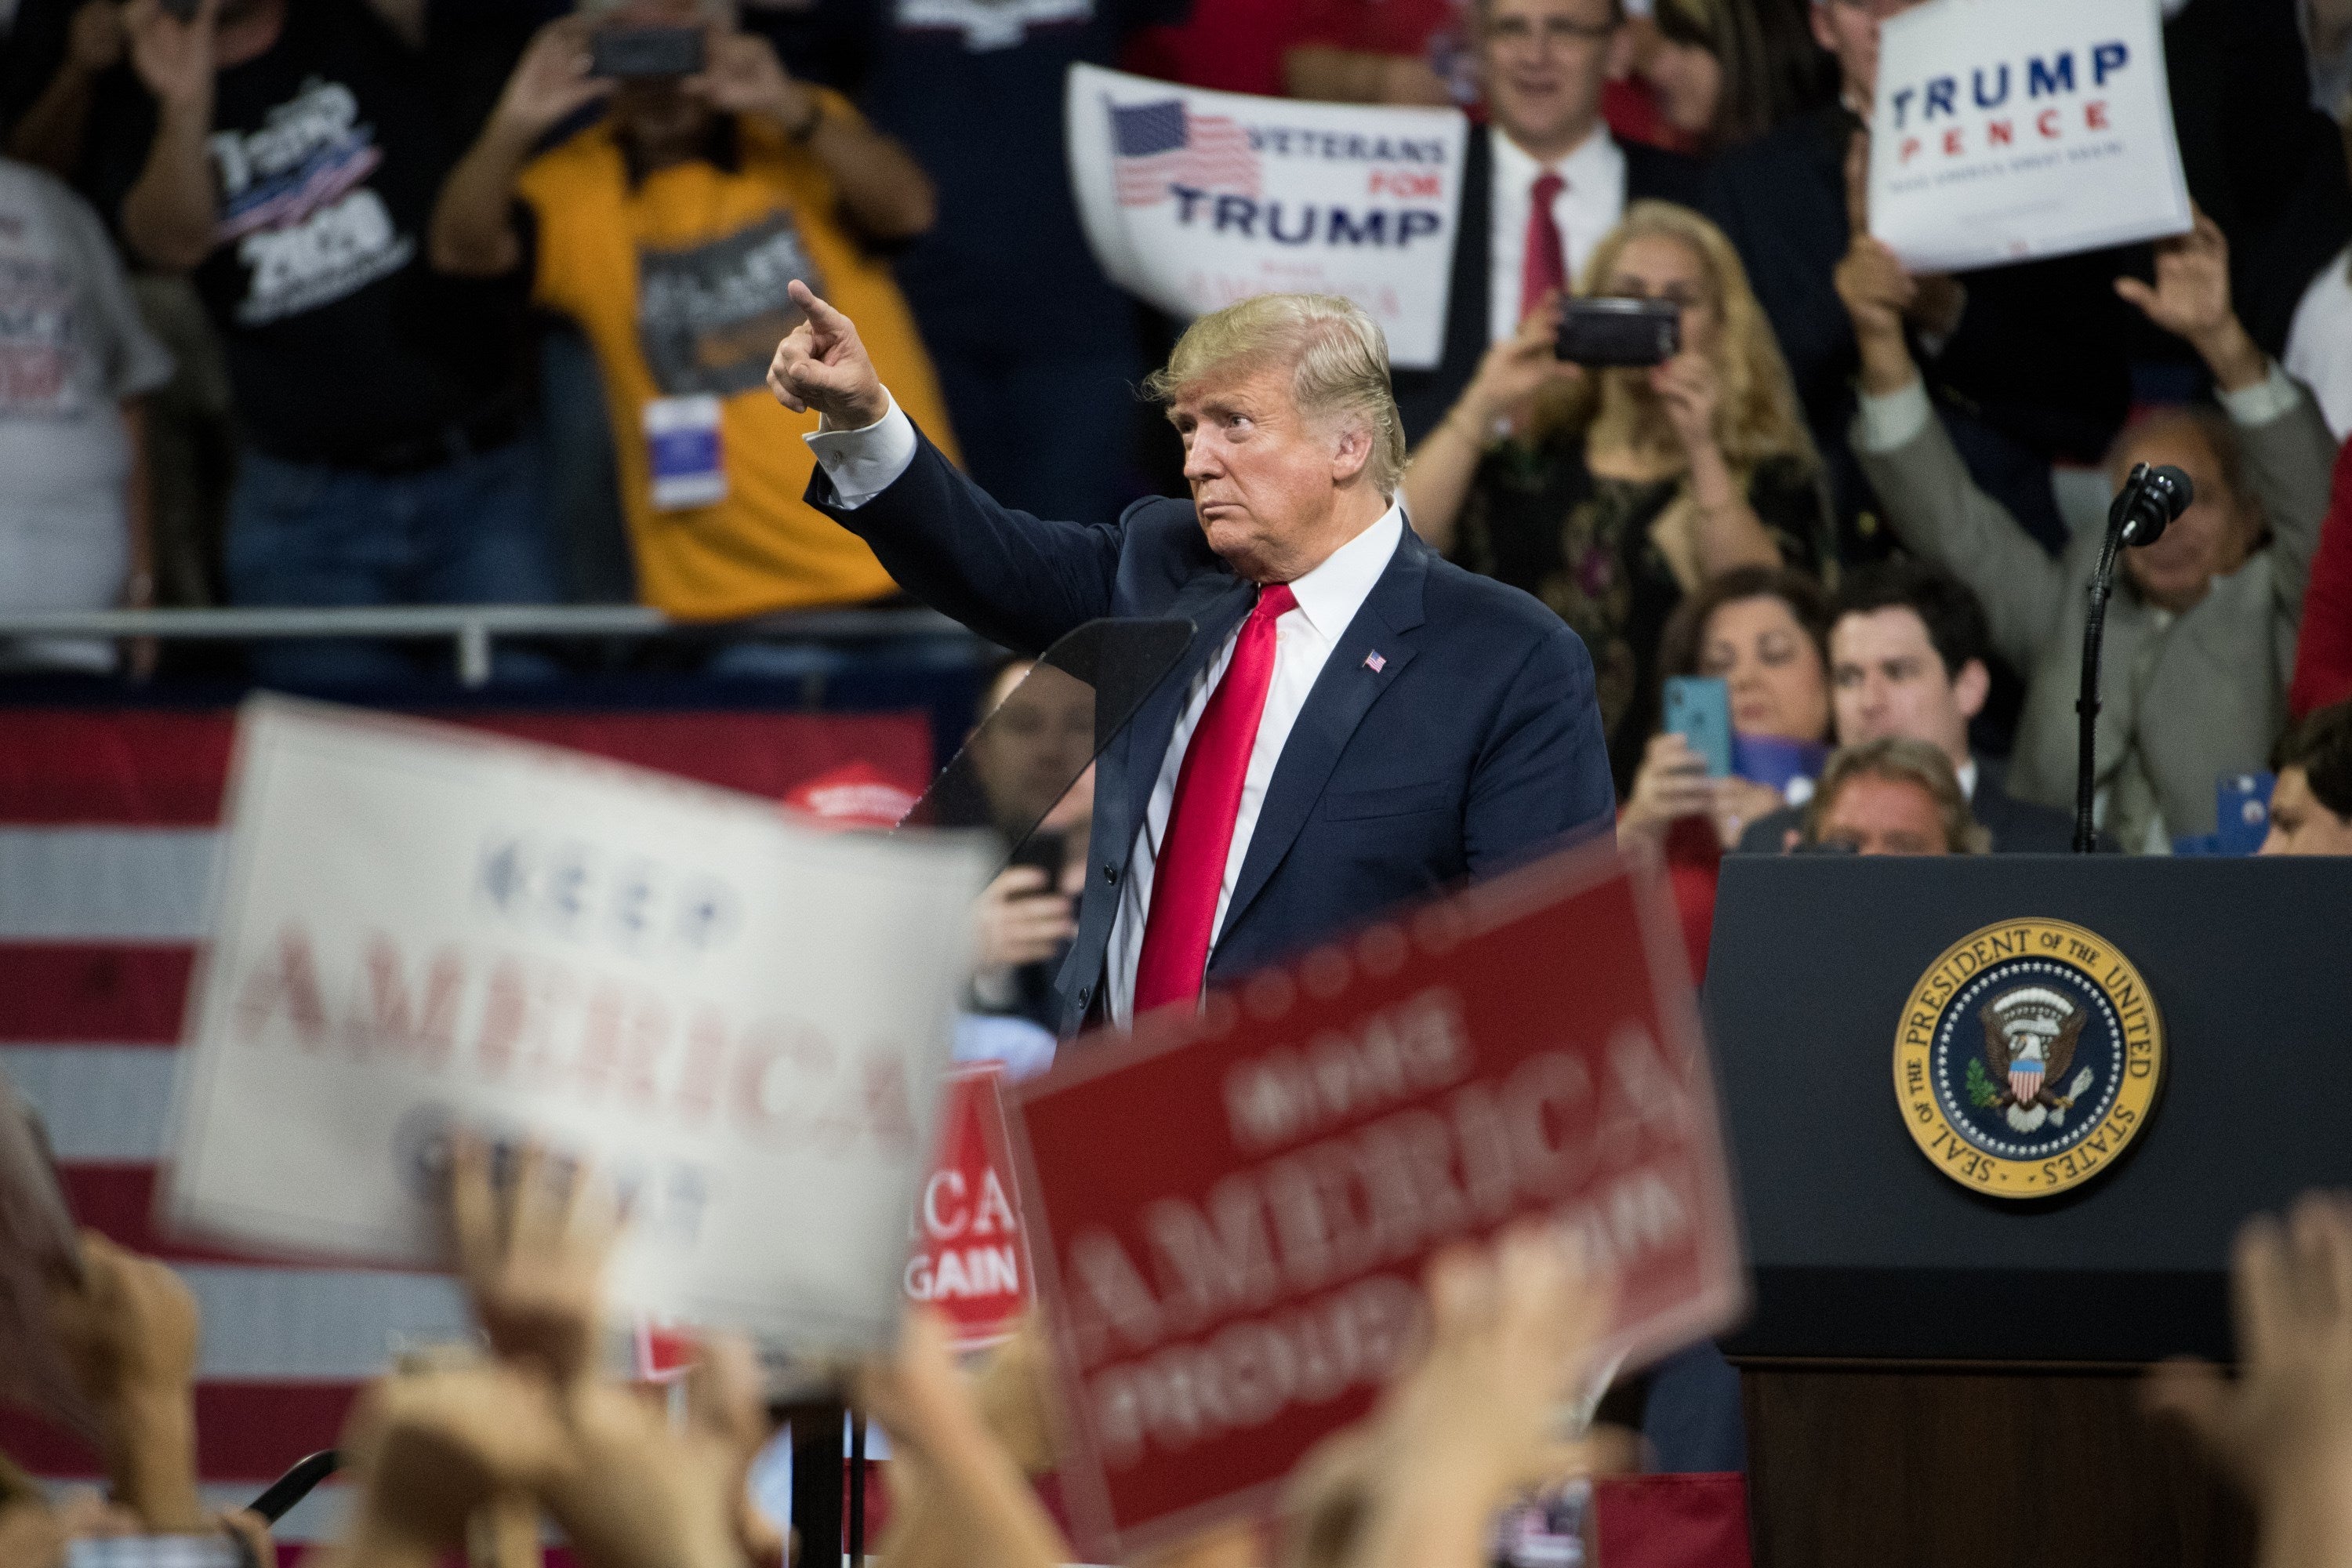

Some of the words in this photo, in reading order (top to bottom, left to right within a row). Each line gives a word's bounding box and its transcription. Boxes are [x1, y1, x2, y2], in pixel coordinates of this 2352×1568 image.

[1891, 38, 2131, 129] TRUMP
[1250, 125, 1447, 165] VETERANS
[1898, 100, 2111, 165] PENCE
[1170, 181, 1443, 250] TRUMP
[1368, 169, 1442, 198] FOR
[2069, 940, 2101, 967] THE
[1906, 929, 2031, 1046] PRESIDENT
[234, 920, 928, 1162] AMERICA
[2103, 966, 2152, 1079] UNITED
[1221, 985, 1472, 1149] MAKE
[1907, 1058, 1923, 1094] THE
[1915, 1102, 1933, 1123] OF
[2042, 1104, 2136, 1185] STATES
[1069, 1019, 1690, 1353] AMERICA
[1929, 1123, 1996, 1182] SEAL
[903, 1247, 1019, 1301] GAIN
